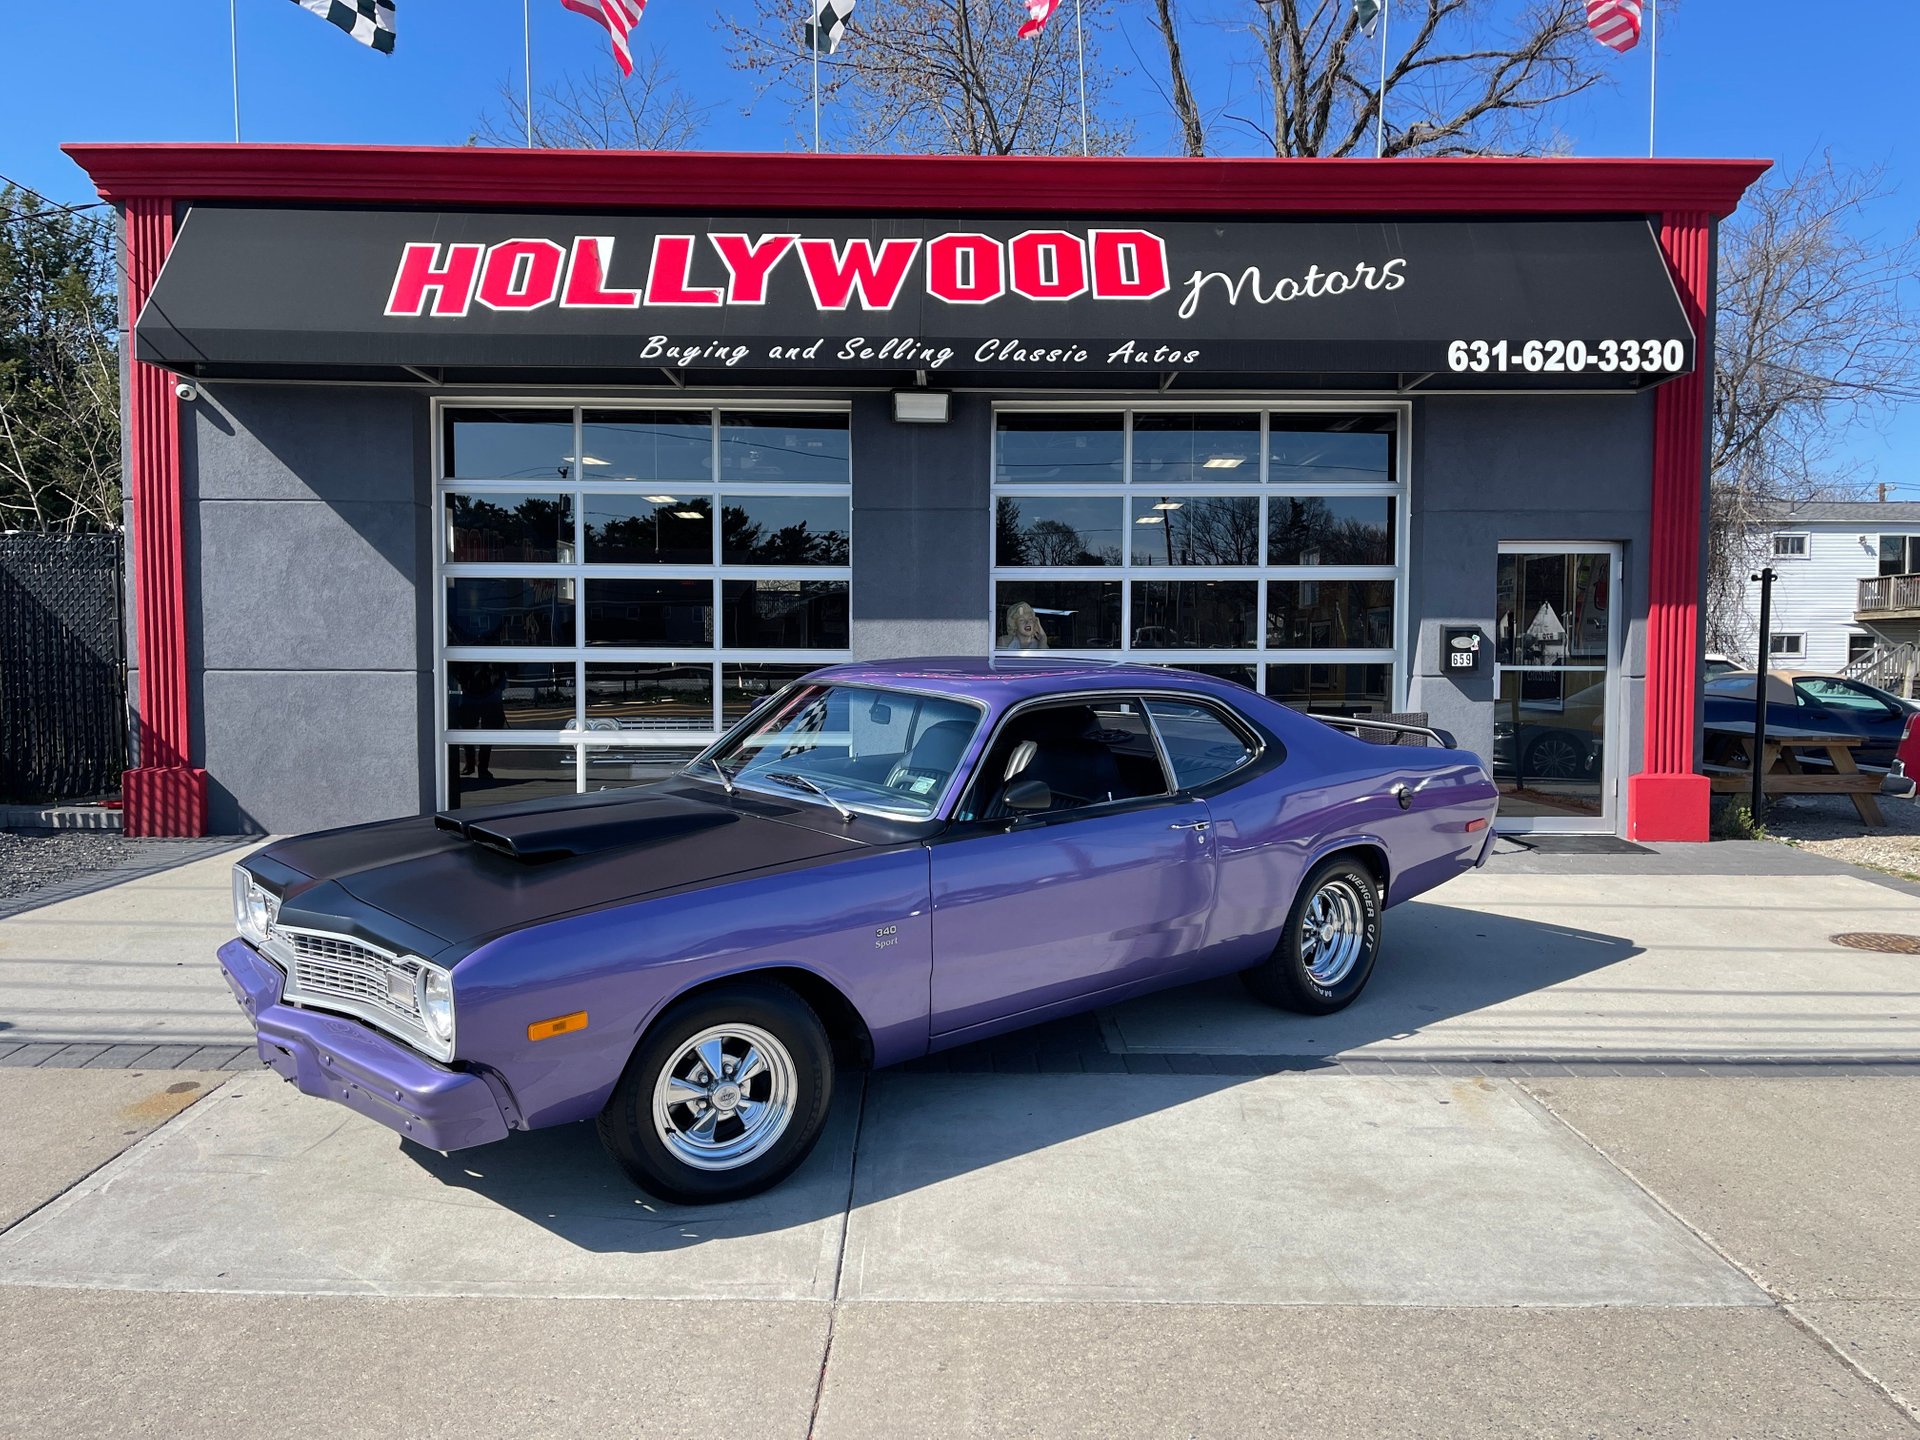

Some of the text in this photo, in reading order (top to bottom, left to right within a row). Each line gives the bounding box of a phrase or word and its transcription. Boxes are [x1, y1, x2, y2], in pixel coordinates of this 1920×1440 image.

[384, 229, 1407, 319] HOLLYWOOD Motors
[640, 335, 1200, 369] Buying and Selling Classic Autos
[1447, 339, 1684, 372] 631-620-3330
[1452, 653, 1471, 666] 659
[1345, 873, 1376, 952] AVENGER G/T
[875, 937, 898, 949] Sport
[876, 925, 897, 937] 340
